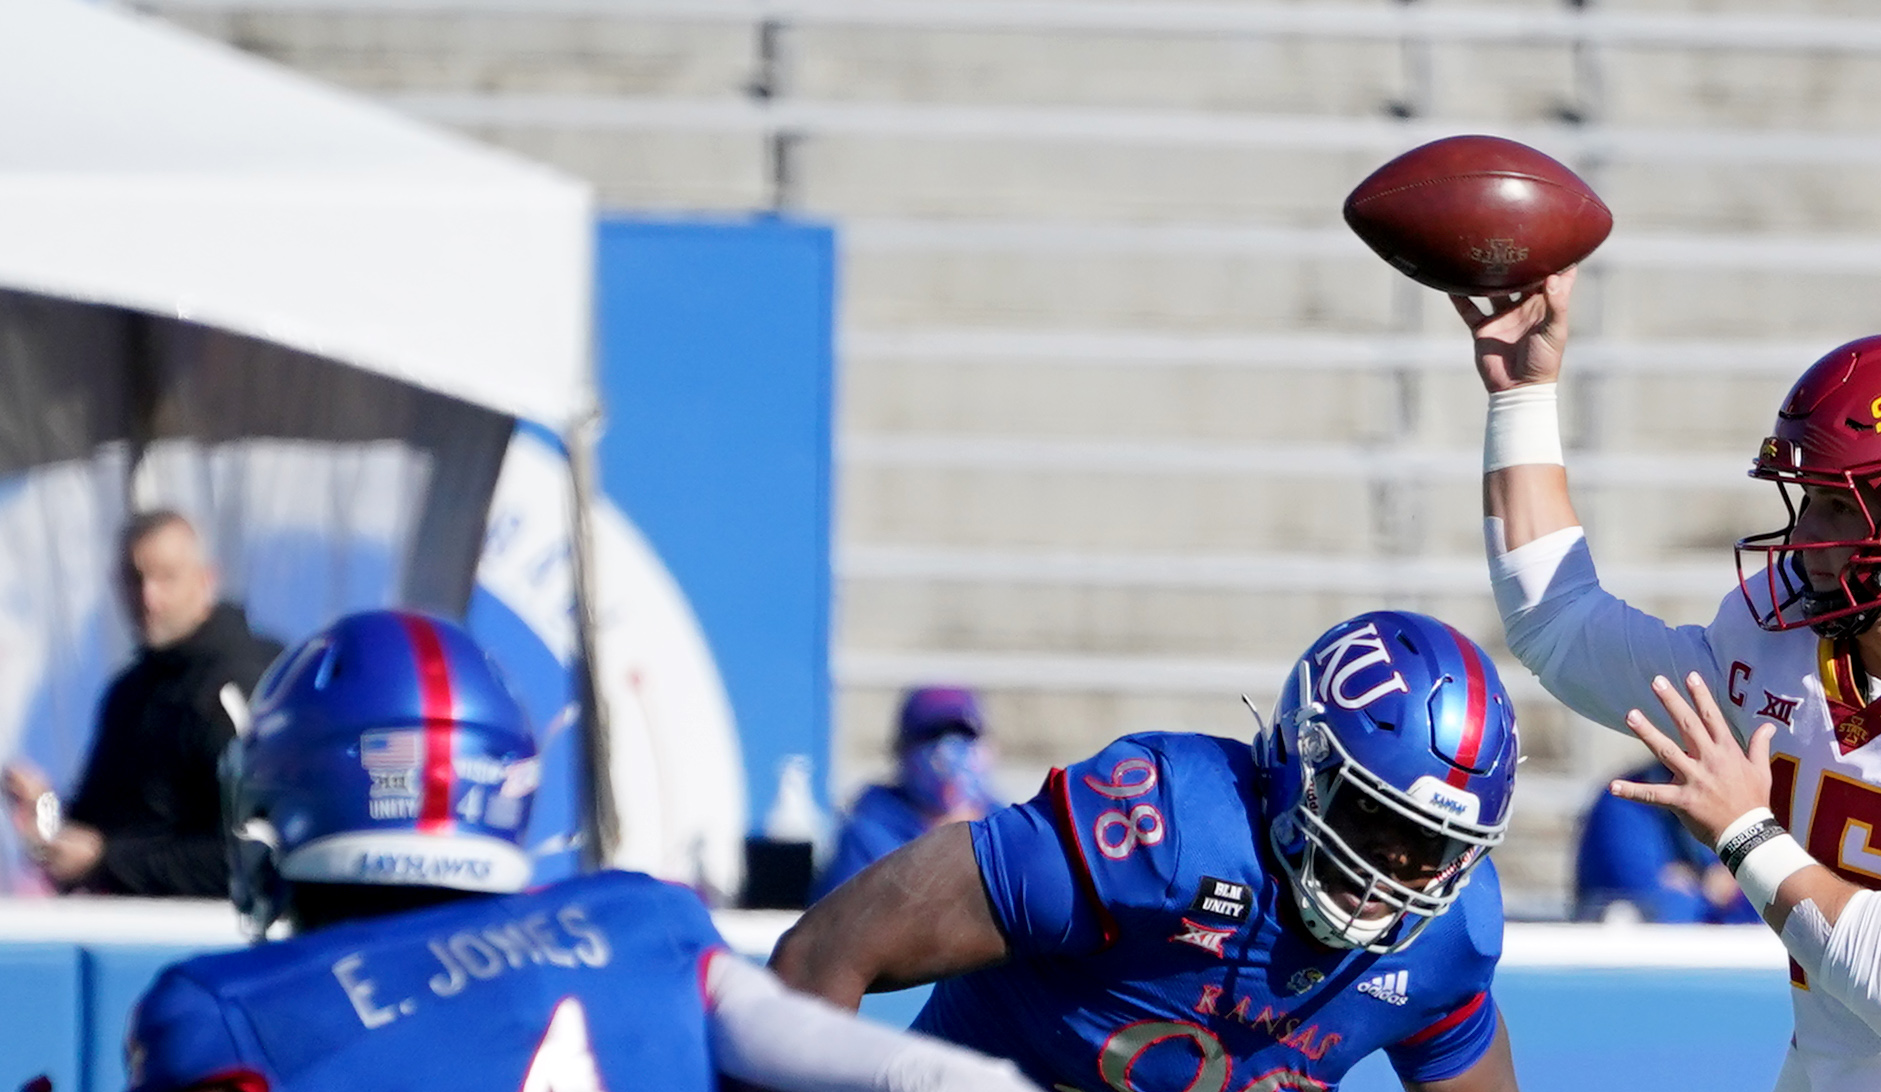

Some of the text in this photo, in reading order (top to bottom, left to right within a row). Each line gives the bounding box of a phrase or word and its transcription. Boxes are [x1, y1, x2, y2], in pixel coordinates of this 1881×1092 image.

[1314, 622, 1411, 710] KU
[1728, 660, 1752, 707] C
[1083, 757, 1166, 861] 98
[1202, 896, 1244, 918] UNITY
[1214, 881, 1243, 901] BLM
[331, 905, 614, 1031] E. JONES
[1356, 981, 1409, 1007] adidas
[1195, 984, 1343, 1061] KANSAS
